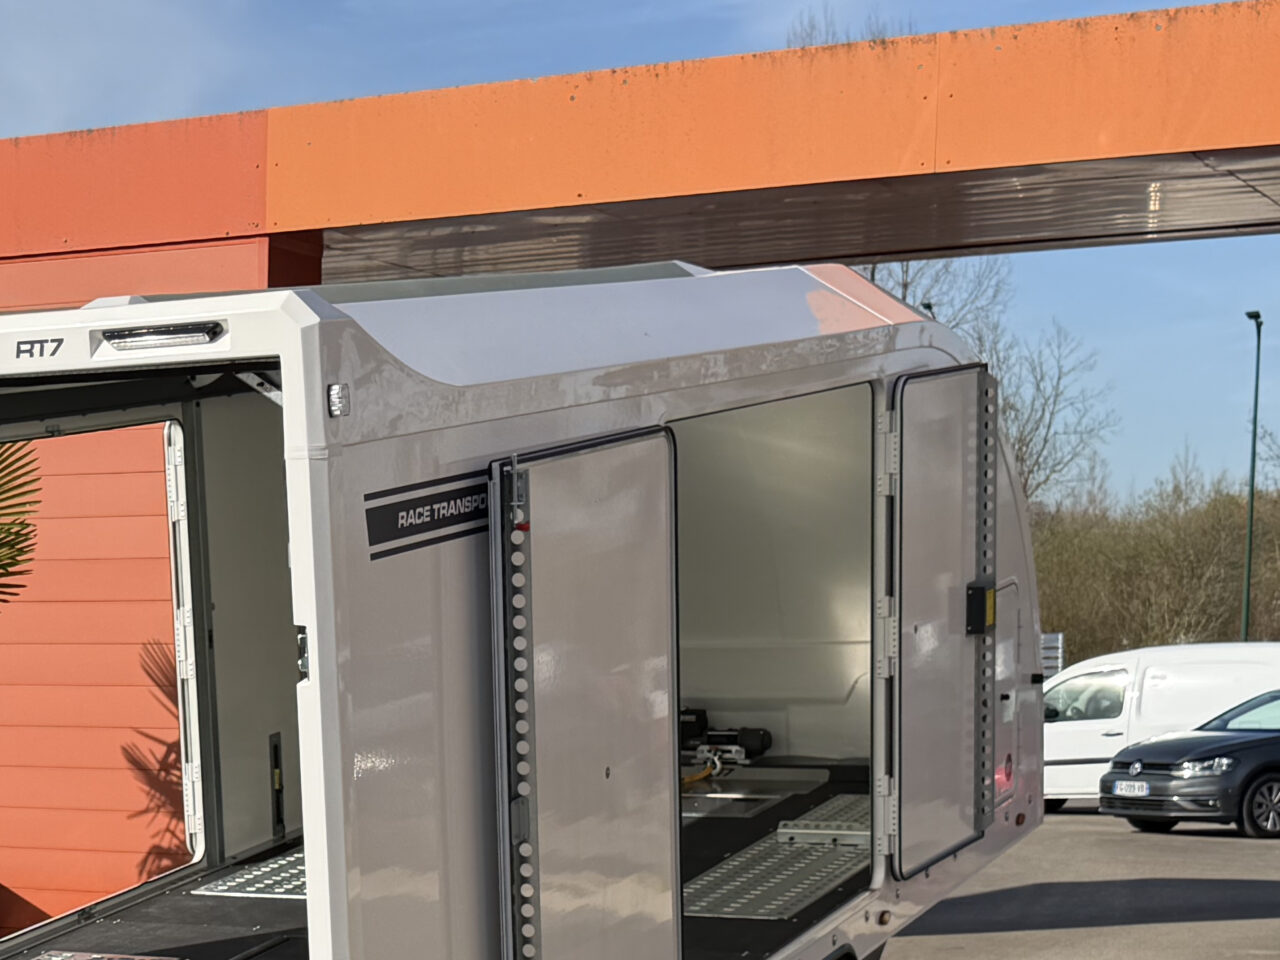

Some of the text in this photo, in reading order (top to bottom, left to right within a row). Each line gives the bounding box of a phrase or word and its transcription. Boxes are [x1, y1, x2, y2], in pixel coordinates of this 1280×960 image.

[15, 337, 65, 359] RT7
[397, 493, 487, 529] RACE TRANSPO
